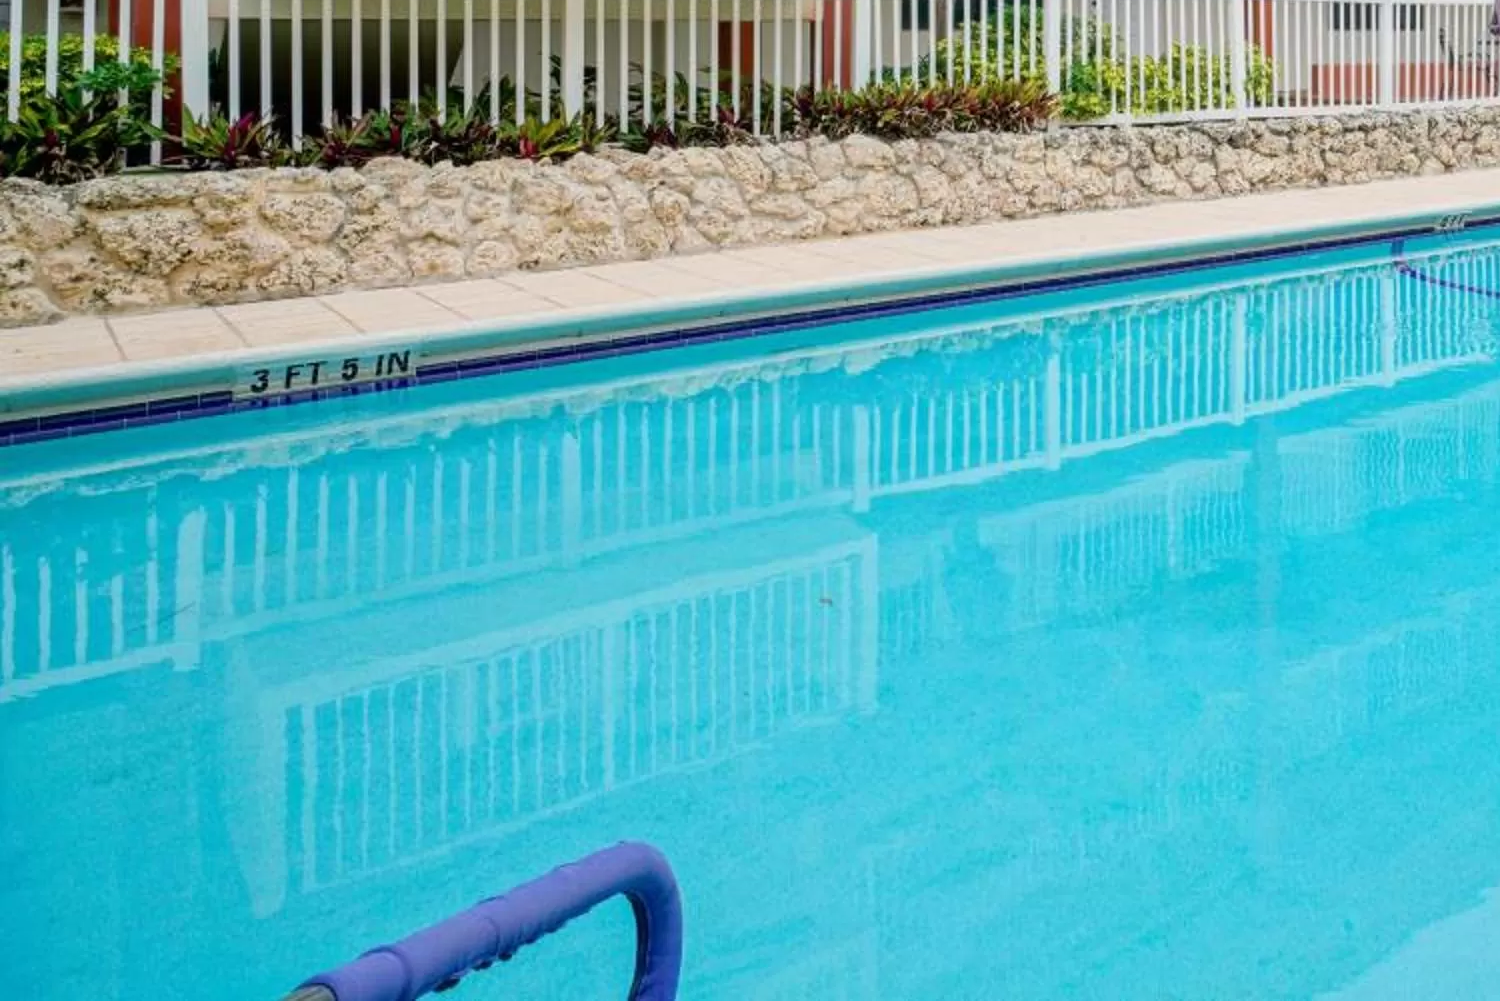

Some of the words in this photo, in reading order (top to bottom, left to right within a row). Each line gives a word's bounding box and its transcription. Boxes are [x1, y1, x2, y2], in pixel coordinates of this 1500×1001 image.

[250, 368, 270, 393] 3
[285, 360, 328, 389] FT
[341, 358, 359, 380] 5
[375, 350, 411, 376] IN
